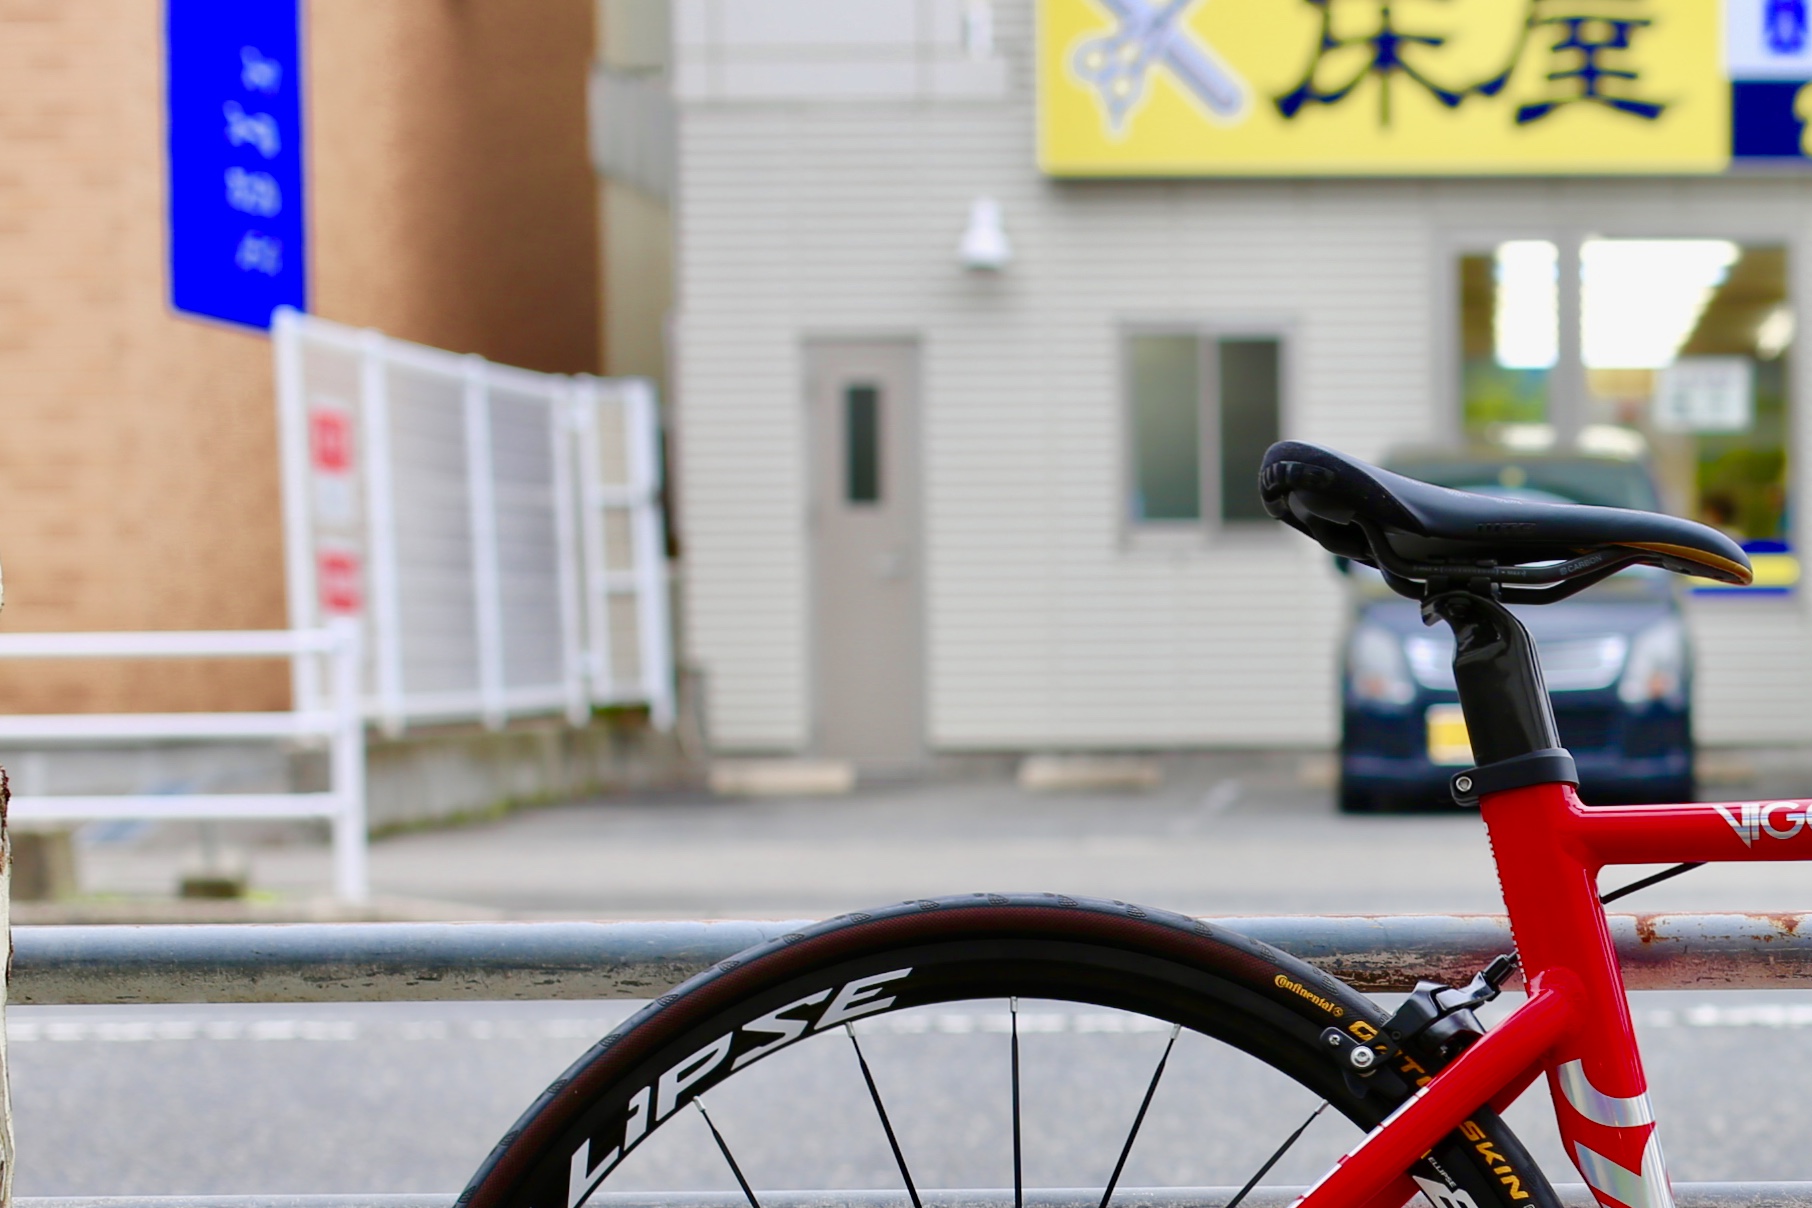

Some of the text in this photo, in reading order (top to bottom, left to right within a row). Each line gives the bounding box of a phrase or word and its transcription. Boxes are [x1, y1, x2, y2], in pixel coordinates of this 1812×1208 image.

[1566, 555, 1604, 574] CARBON
[1274, 974, 1336, 1013] Continental
[1427, 1156, 1457, 1190] ELLIPSE
